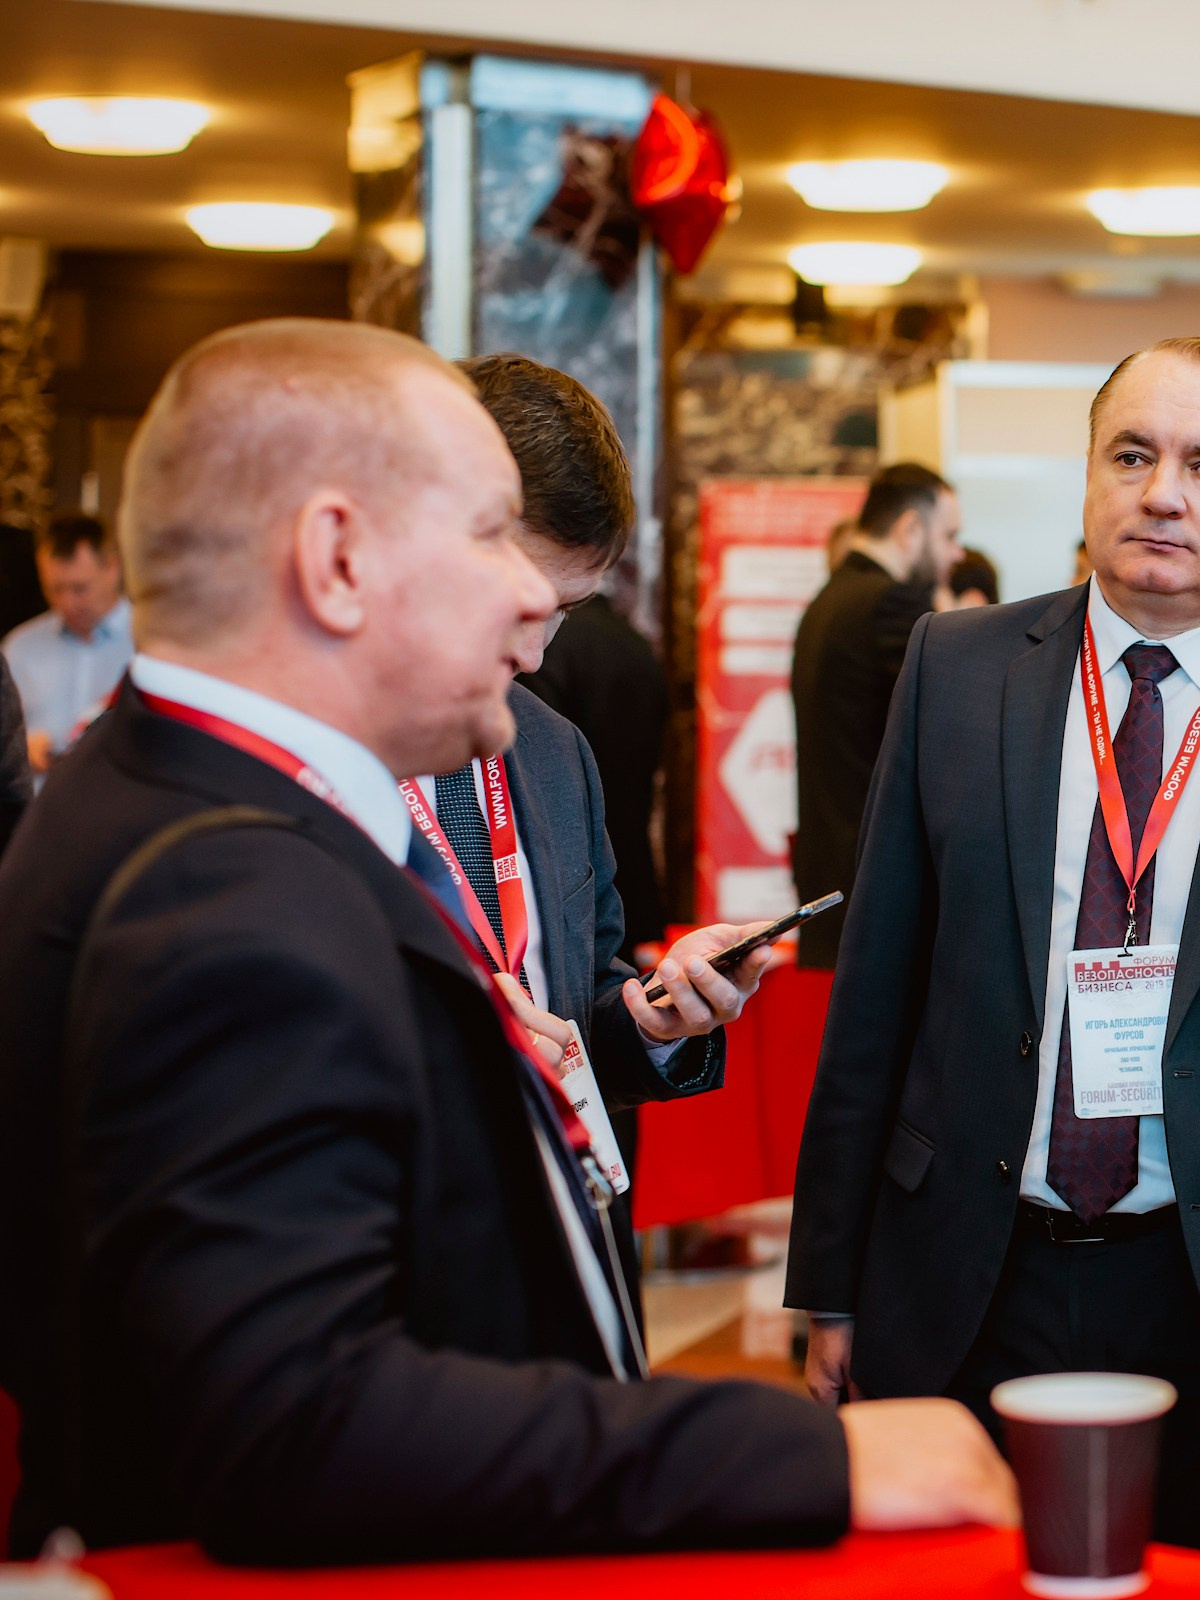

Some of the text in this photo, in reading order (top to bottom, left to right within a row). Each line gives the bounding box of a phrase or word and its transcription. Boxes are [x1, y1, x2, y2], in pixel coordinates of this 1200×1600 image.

[1086, 660, 1093, 675] НА
[1088, 673, 1099, 706] ФОРУМЕ
[1093, 711, 1101, 725] ТЫ
[1095, 724, 1103, 737] НЕ
[1163, 756, 1190, 801] ФОРУМ
[398, 779, 433, 831] БЕЗОП
[1133, 956, 1175, 966] ФОРУМ
[1076, 966, 1175, 982] БЕЗОПАСНОСТЬ
[1077, 981, 1133, 994] БИЗНЕСА
[1145, 980, 1163, 990] 2019
[1085, 1019, 1108, 1030] ИГОРЬ
[1114, 1029, 1144, 1041] ФУРСОВ
